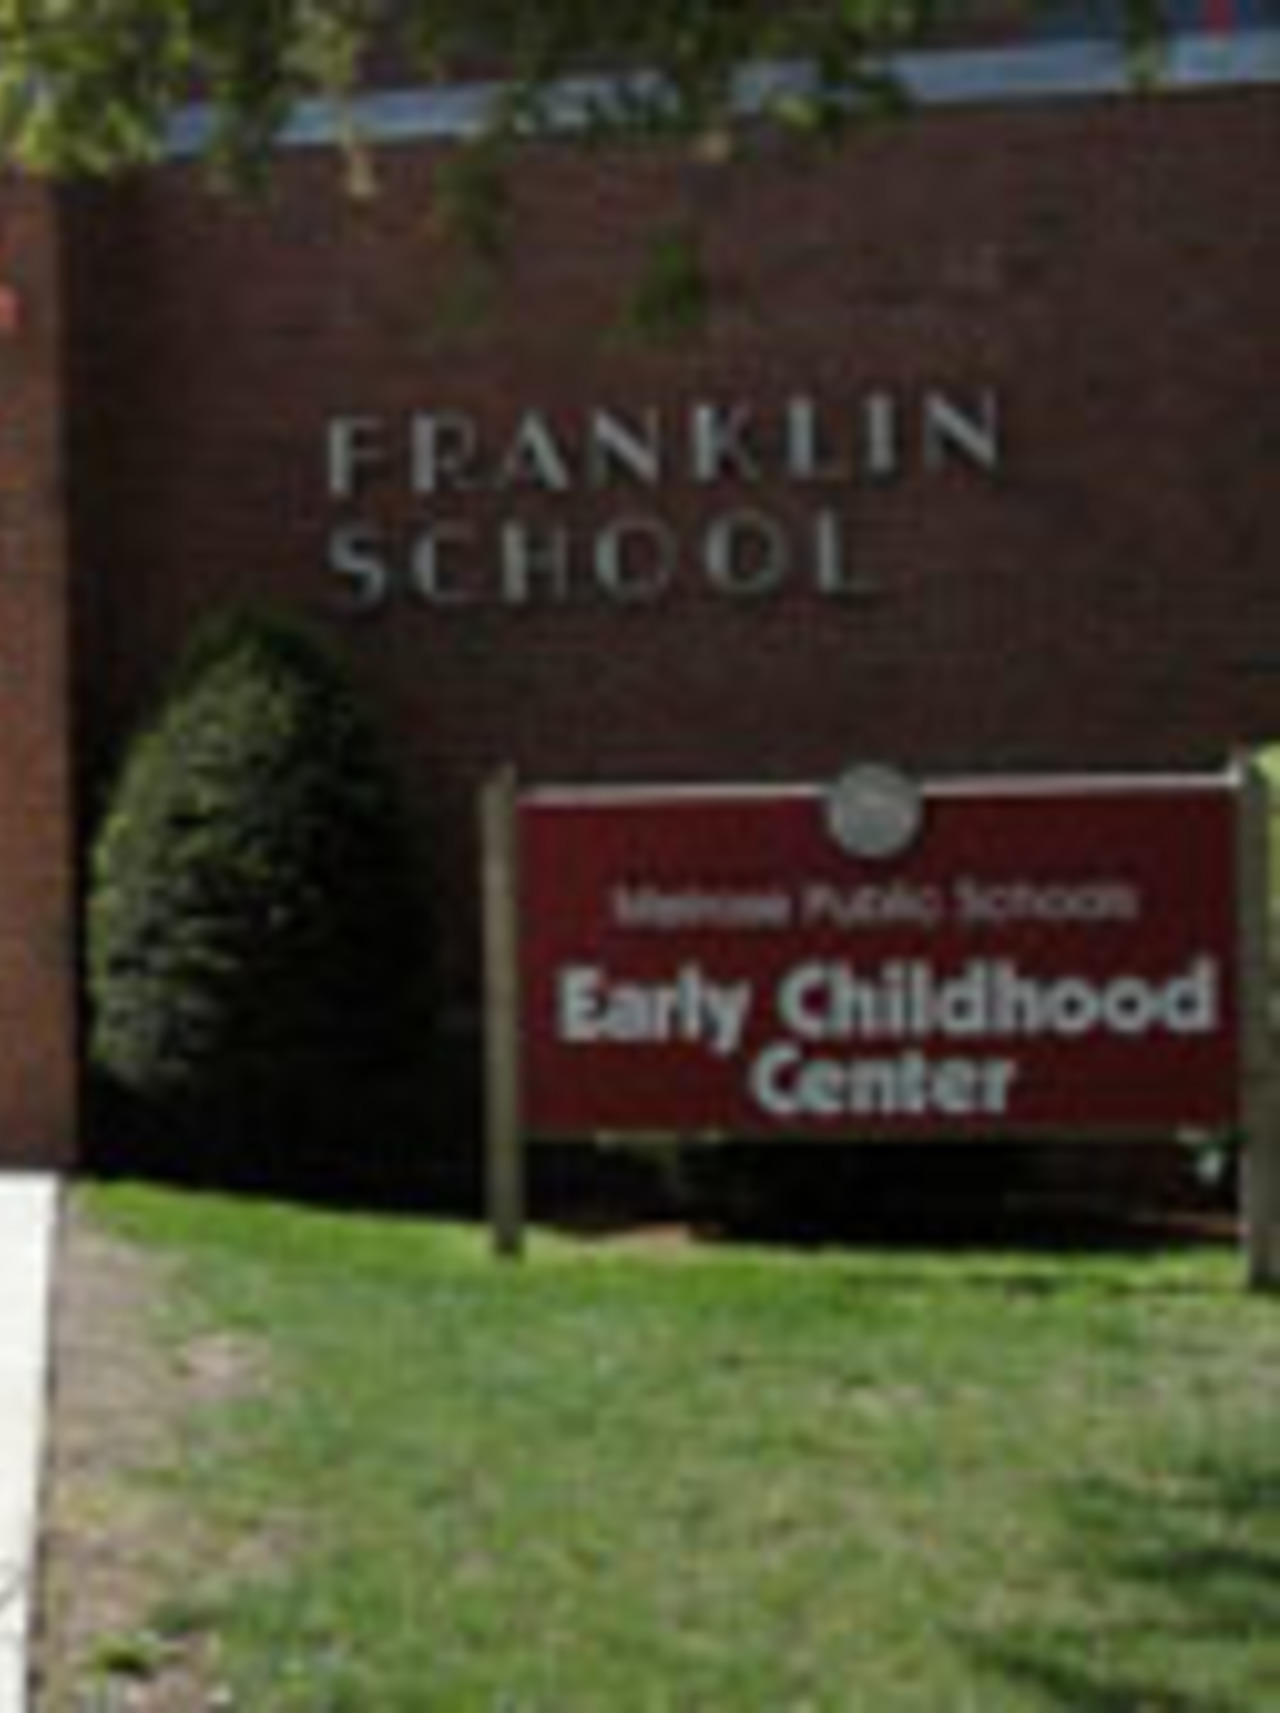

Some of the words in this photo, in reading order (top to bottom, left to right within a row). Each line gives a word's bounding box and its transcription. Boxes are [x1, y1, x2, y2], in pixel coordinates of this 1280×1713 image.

[328, 390, 1000, 496] FRANKLIN
[328, 508, 882, 604] SCHOOL
[556, 964, 752, 1052] Early
[776, 956, 1218, 1036] Childhood
[750, 1042, 1016, 1116] Center
